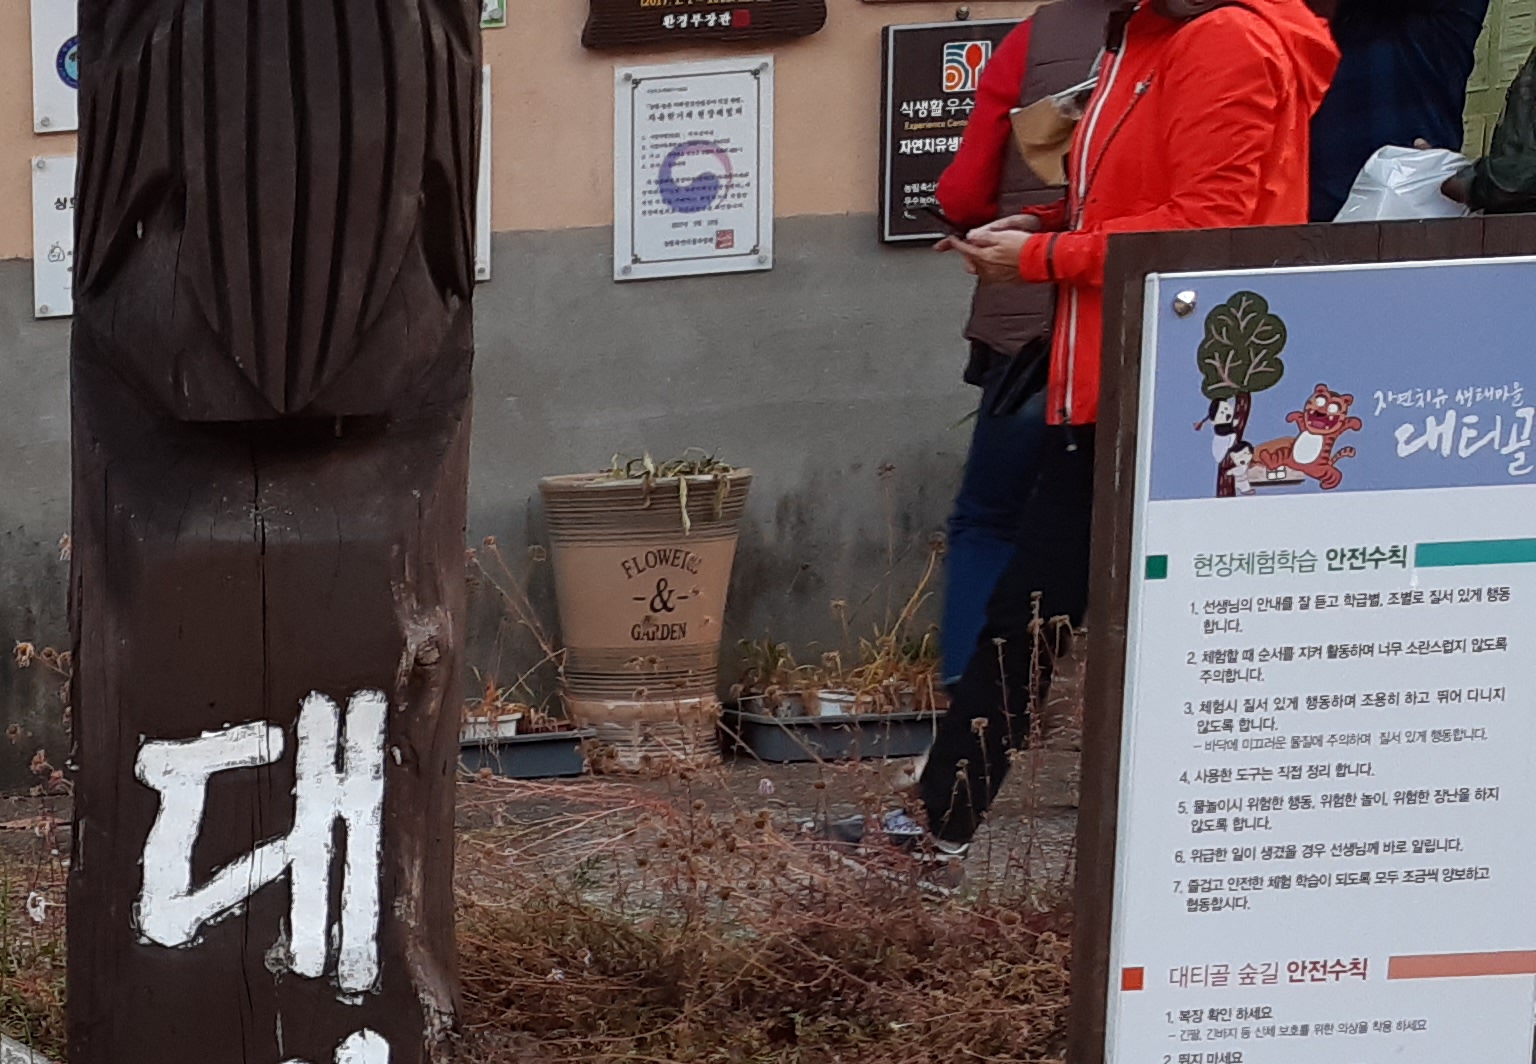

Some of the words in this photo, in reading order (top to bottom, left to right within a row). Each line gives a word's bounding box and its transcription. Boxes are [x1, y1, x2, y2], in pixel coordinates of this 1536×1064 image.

[900, 100, 943, 118] 식생활
[1373, 388, 1449, 416] 자연치유
[1455, 381, 1525, 407] 생태마을
[1394, 406, 1536, 476] 대티골
[1194, 548, 1318, 578] 현장체험학습
[1326, 544, 1407, 572] 안전수칙
[1191, 601, 1198, 616] 1.
[1203, 598, 1253, 615] 선생님의
[1257, 596, 1293, 613] 안내를
[1298, 595, 1311, 611] 잘
[1314, 594, 1339, 609] 듣고
[1387, 589, 1425, 606] 조별로
[1429, 589, 1453, 604] 질서
[1458, 587, 1482, 603] 있게
[1487, 586, 1510, 603] 행동
[1204, 617, 1243, 634] 합니다.
[1202, 648, 1239, 665] 체험할
[1242, 648, 1254, 662] 때
[1258, 646, 1295, 663] 순서를
[1298, 645, 1322, 660] 지켜
[1326, 642, 1374, 660] 활동하며
[1378, 641, 1403, 656] 너무
[1405, 639, 1466, 656] 소란스럽지
[1199, 666, 1264, 684] 주의합니다.
[1184, 701, 1194, 716] 3.
[1199, 699, 1238, 715] 체험시
[1243, 697, 1268, 713] 질서
[1273, 696, 1299, 711] 있게
[1306, 693, 1356, 711] 행동하며
[1360, 691, 1400, 708] 조용히
[1405, 690, 1430, 705] 하고
[1437, 689, 1462, 704] 뛰어
[1467, 687, 1505, 703] 다니지
[1239, 716, 1278, 732] 합니다.
[1179, 771, 1190, 785] 4.
[1194, 768, 1232, 784] 사용한
[1235, 766, 1273, 783] 도구는
[1277, 765, 1302, 781] 직접
[1306, 763, 1331, 780] 정리
[1335, 762, 1375, 777] 합니다.
[1178, 801, 1188, 814] 5.
[1193, 797, 1243, 814] 물놀이시
[1288, 794, 1315, 810] 행동,
[1360, 792, 1388, 807] 놀이,
[1434, 787, 1471, 804] 장난을
[1475, 787, 1499, 802] 하지
[1233, 815, 1272, 832] 합니다.
[1175, 850, 1186, 863] 6.
[1190, 847, 1228, 864] 위급한
[1232, 846, 1256, 862] 일이
[1261, 844, 1298, 860] 생겼을
[1302, 844, 1326, 859] 경우
[1330, 840, 1379, 857] 선생님께
[1383, 840, 1408, 855] 바로
[1412, 837, 1463, 854] 알립니다.
[1173, 881, 1183, 893] 7.
[1187, 877, 1224, 894] 즐겁고
[1227, 875, 1264, 892] 안전한
[1267, 874, 1291, 890] 체험
[1296, 872, 1332, 889] 학습이
[1335, 872, 1371, 886] 되도록
[1374, 870, 1399, 885] 모두
[1401, 868, 1439, 884] 조금씩
[1442, 865, 1490, 883] 양보하고
[1186, 895, 1250, 913] 협동합시다.
[1170, 964, 1230, 988] 대티골
[1238, 962, 1278, 986] 숲길
[1287, 957, 1368, 983] 안전수칙
[1166, 1011, 1174, 1024] 1.
[1179, 1009, 1204, 1024] 복장
[1207, 1007, 1232, 1023] 확인
[1236, 1006, 1273, 1021] 하세요
